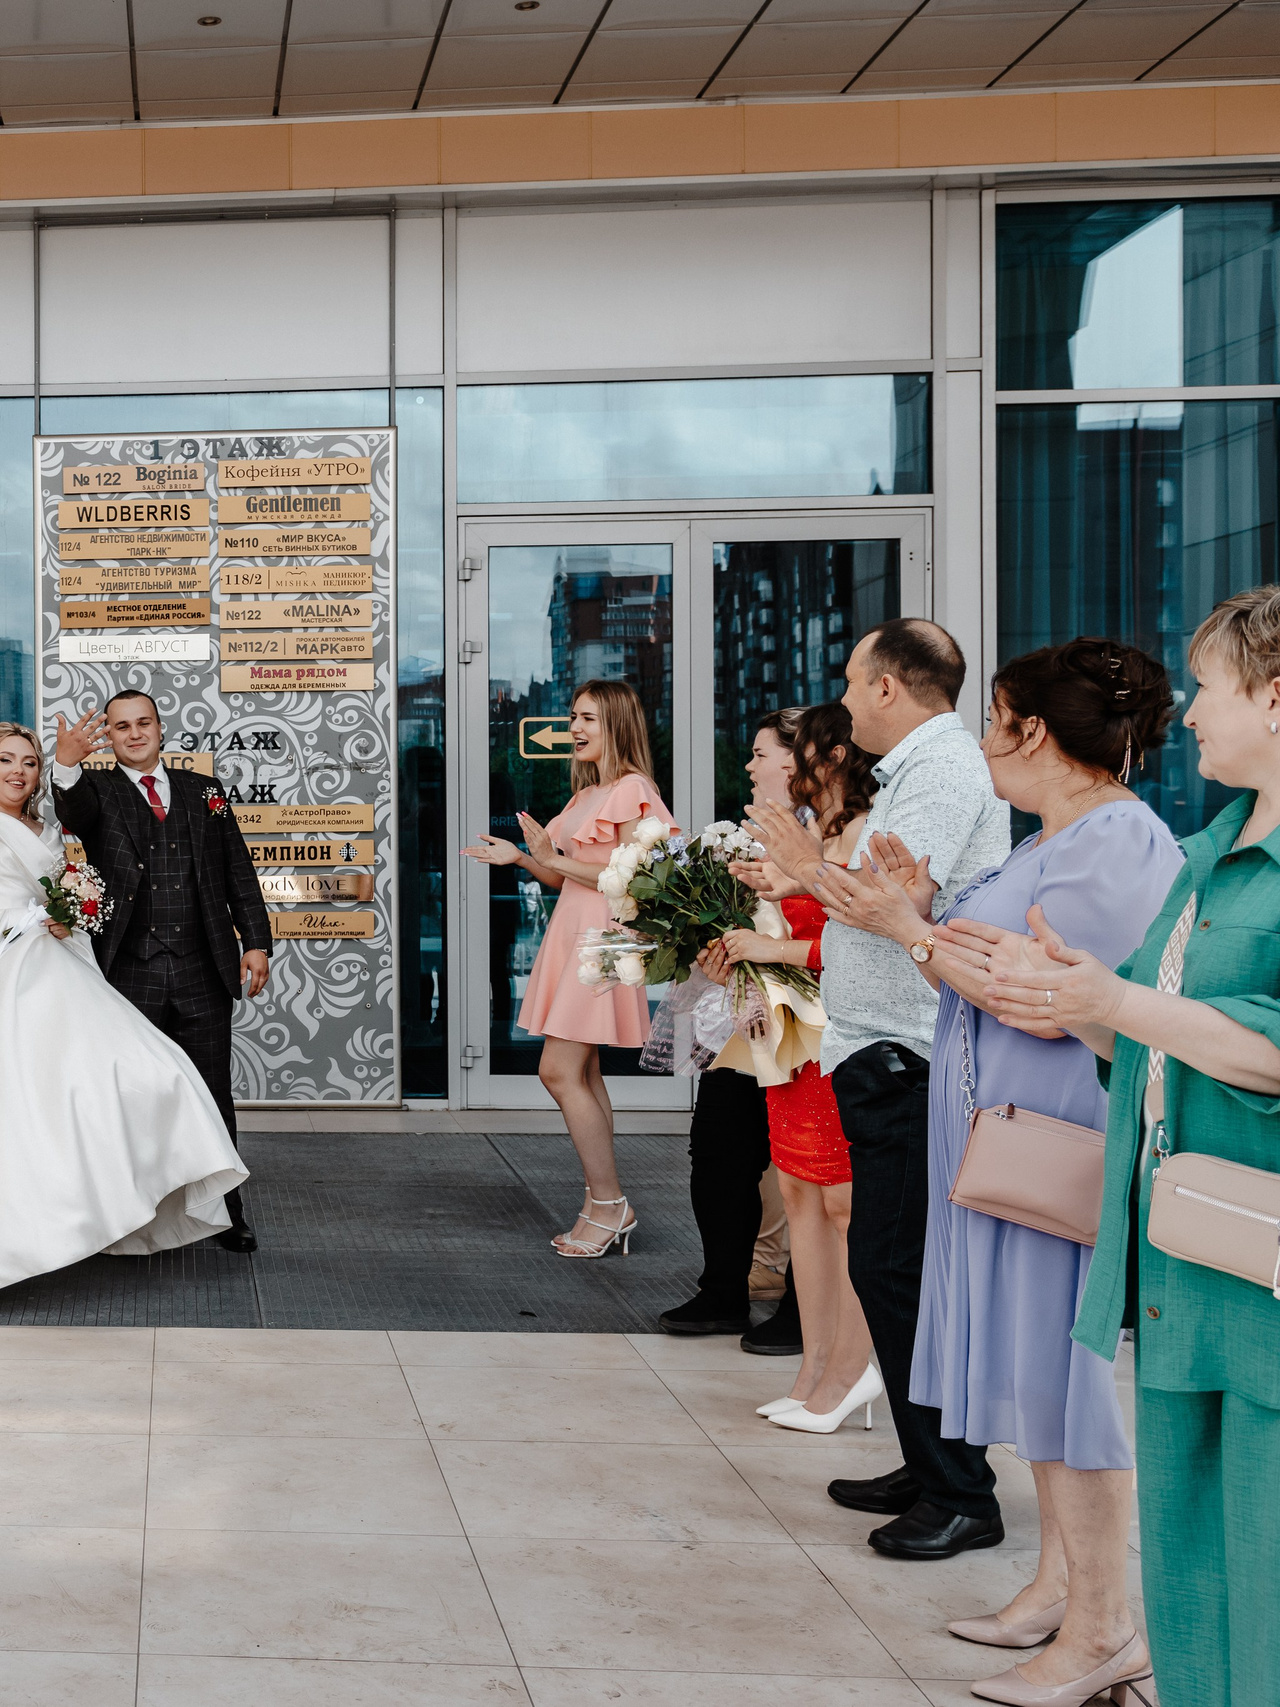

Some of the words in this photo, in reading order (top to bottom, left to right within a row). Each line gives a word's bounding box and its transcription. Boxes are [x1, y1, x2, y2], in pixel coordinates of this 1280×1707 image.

[150, 440, 163, 460] 1
[180, 437, 287, 459] ЭТАЖ
[136, 465, 198, 484] Boginia
[225, 465, 301, 481] Кофейня
[308, 463, 365, 477] «УТРО»
[73, 474, 90, 486] №
[96, 473, 121, 486] 122
[246, 496, 341, 513] Gentlemen
[77, 504, 191, 522] WLDBERRIS
[90, 535, 134, 544] АГЕНТСТВО
[137, 533, 206, 543] НЕДВИЖИМОСТИ
[225, 538, 258, 548] №110
[276, 534, 304, 542] «МИР
[307, 534, 346, 542] ВКУСА»
[60, 542, 81, 551] 112/4
[101, 568, 151, 577] АГЕНТСТВО
[154, 567, 196, 576] ТУРИЗМА
[60, 576, 82, 586] 112/4
[225, 573, 262, 585] 118/2
[323, 579, 366, 587] ПЕДИКЮР
[143, 603, 186, 611] ОТДЕЛЕНИЕ
[283, 604, 361, 618] «MALINA»
[136, 613, 170, 621] «ЕДИНАЯ
[226, 610, 261, 620] №122
[79, 642, 123, 655] Цветы
[134, 640, 189, 653] АВГУСТ
[228, 641, 278, 654] №112/2
[250, 667, 292, 678] Мама
[296, 667, 347, 680] рядом
[180, 731, 282, 751] ЭТАЖ
[164, 757, 194, 770] АГС
[226, 785, 278, 803] АЖ
[251, 845, 332, 861] ЕМПИОН
